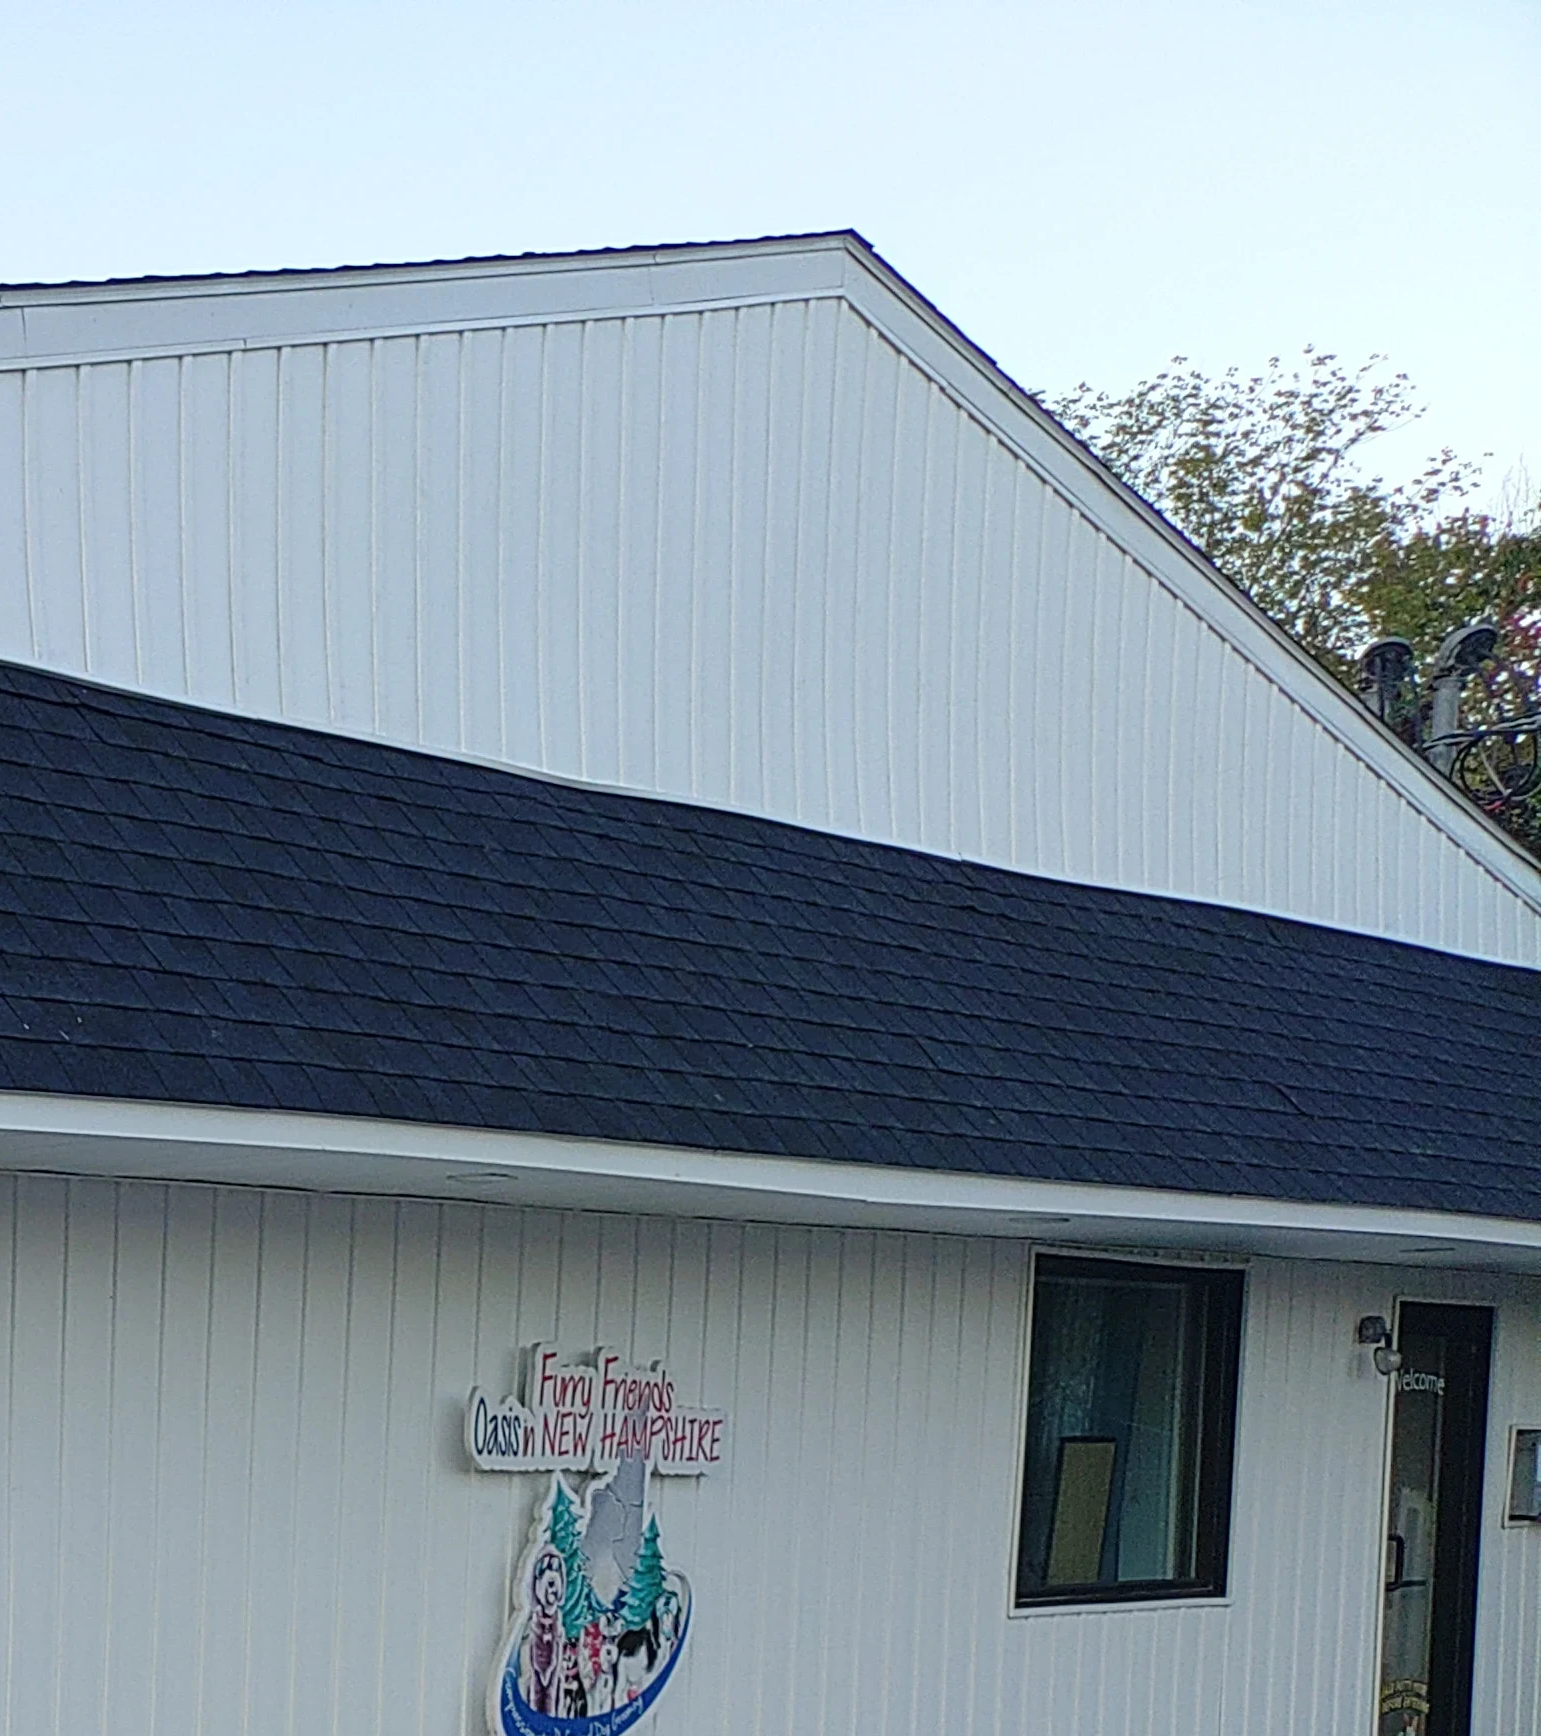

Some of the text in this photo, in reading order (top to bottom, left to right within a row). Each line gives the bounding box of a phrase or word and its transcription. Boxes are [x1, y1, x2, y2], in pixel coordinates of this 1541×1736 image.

[539, 1352, 675, 1419] Furry Friends
[474, 1396, 724, 1463] Oasis in NEW HAMPSHIRE
